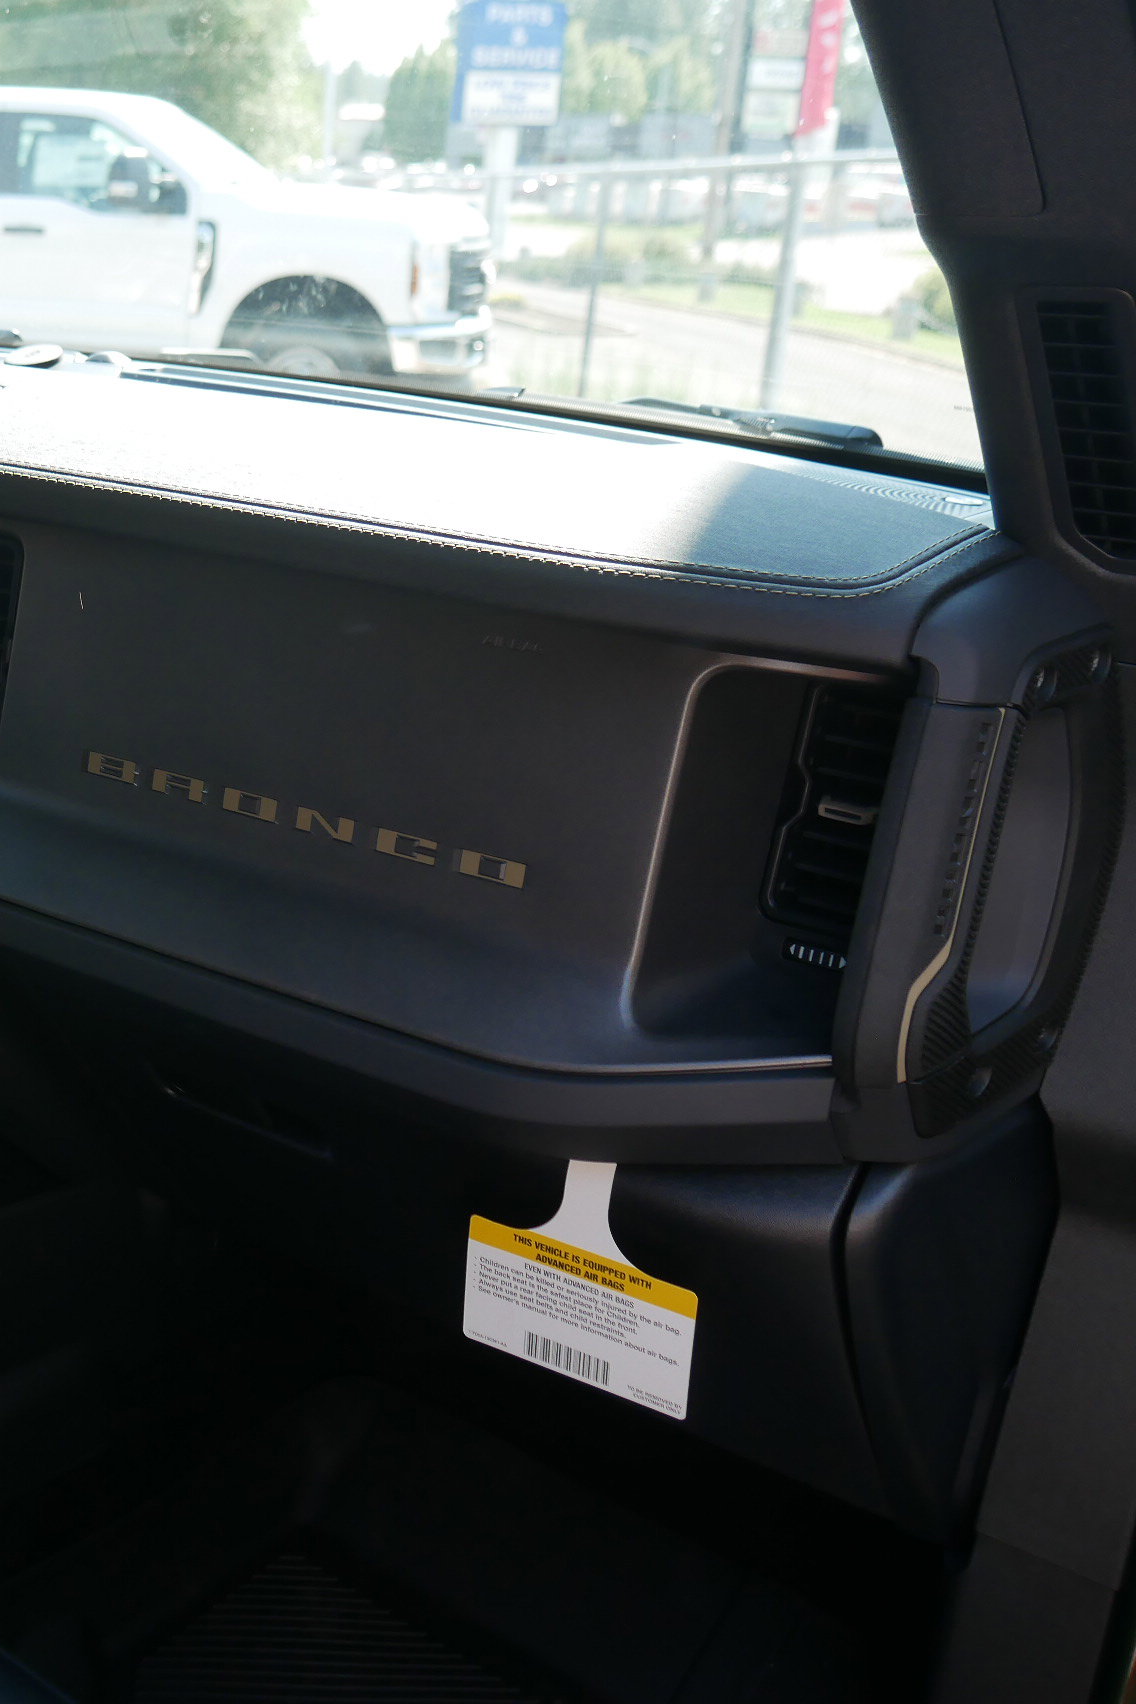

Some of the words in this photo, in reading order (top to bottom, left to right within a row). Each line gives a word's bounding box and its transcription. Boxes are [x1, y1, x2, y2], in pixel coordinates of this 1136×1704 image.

[485, 2, 553, 26] PARTS
[472, 45, 561, 69] SERVICE
[85, 749, 527, 889] BRONCO
[513, 1234, 532, 1247] THIS
[535, 1241, 569, 1260] VEHICLE
[572, 1254, 580, 1264] IS
[583, 1257, 626, 1280] EQUIPPED
[629, 1274, 652, 1290] WITH
[525, 1263, 541, 1275] EVEN
[544, 1269, 561, 1282] WITH
[563, 1278, 599, 1296] ADVANCED
[601, 1291, 613, 1300] AIR
[615, 1296, 634, 1309] BAGS
[536, 1253, 581, 1276] ADVANCED
[584, 1270, 598, 1282] AIR
[601, 1277, 625, 1291] BAGS
[479, 1271, 499, 1283] Never
[501, 1280, 512, 1288] put
[520, 1286, 534, 1295] rear
[536, 1291, 557, 1305] facing
[559, 1300, 576, 1312] child
[579, 1308, 593, 1318] seat
[605, 1317, 616, 1327] the
[618, 1322, 637, 1335] front.
[479, 1279, 503, 1292] Always
[520, 1293, 534, 1303] seat
[536, 1299, 553, 1311] belts
[555, 1308, 568, 1316] and
[570, 1313, 588, 1323] child
[590, 1320, 626, 1338] restraints.
[480, 1257, 509, 1271] Children
[511, 1268, 523, 1277] can
[536, 1277, 554, 1289] killed
[566, 1289, 599, 1305] seriously
[601, 1300, 626, 1315] injured
[628, 1310, 637, 1320] by
[640, 1314, 651, 1324] the
[653, 1321, 663, 1329] air
[665, 1324, 682, 1335] bag.
[480, 1264, 492, 1273] The
[495, 1269, 510, 1280] back
[513, 1277, 527, 1285] seat
[537, 1284, 548, 1293] the
[550, 1290, 571, 1300] safest
[574, 1297, 593, 1310] place
[595, 1306, 605, 1314] for
[607, 1310, 640, 1328] Children.
[479, 1285, 491, 1295] See
[493, 1292, 519, 1305] owner's
[522, 1302, 547, 1316] manual
[561, 1317, 579, 1328] more
[581, 1324, 623, 1344] information
[625, 1340, 645, 1353] about
[647, 1349, 657, 1357] air
[658, 1353, 679, 1367] bags.
